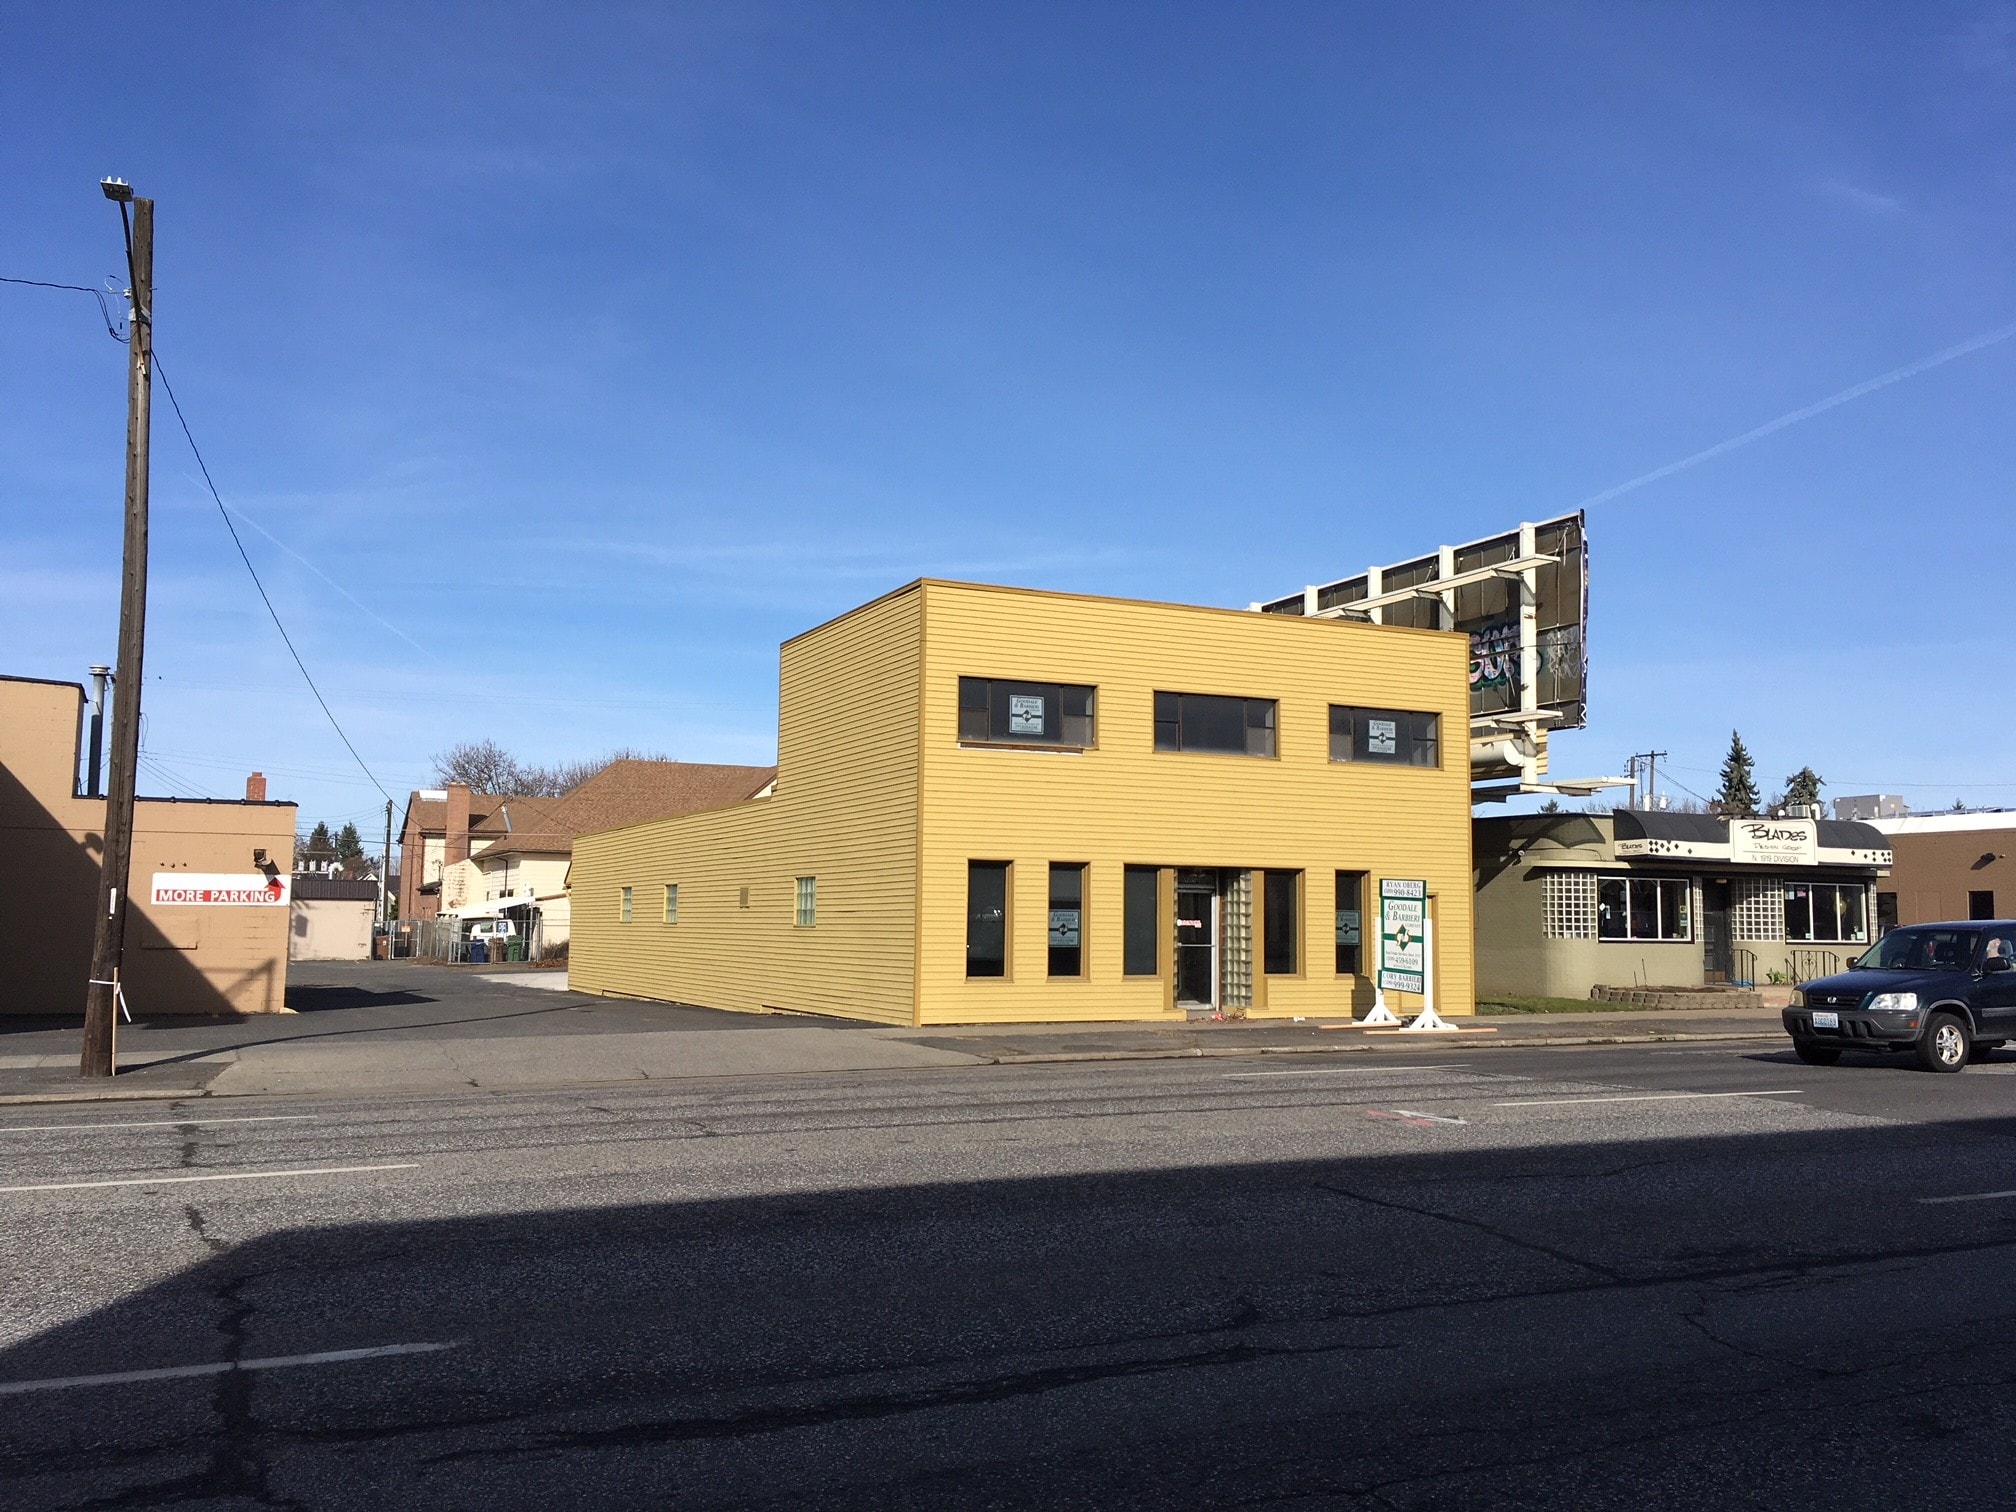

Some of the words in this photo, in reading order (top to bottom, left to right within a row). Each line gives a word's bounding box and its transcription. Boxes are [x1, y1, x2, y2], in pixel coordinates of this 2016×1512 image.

[1740, 824, 1808, 841] BLADES
[1774, 855, 1799, 863] DIVISION
[160, 890, 204, 902] MORE
[211, 890, 275, 902] PARKING
[1388, 901, 1418, 912] GOODALE
[1392, 911, 1420, 922] BARBIERI
